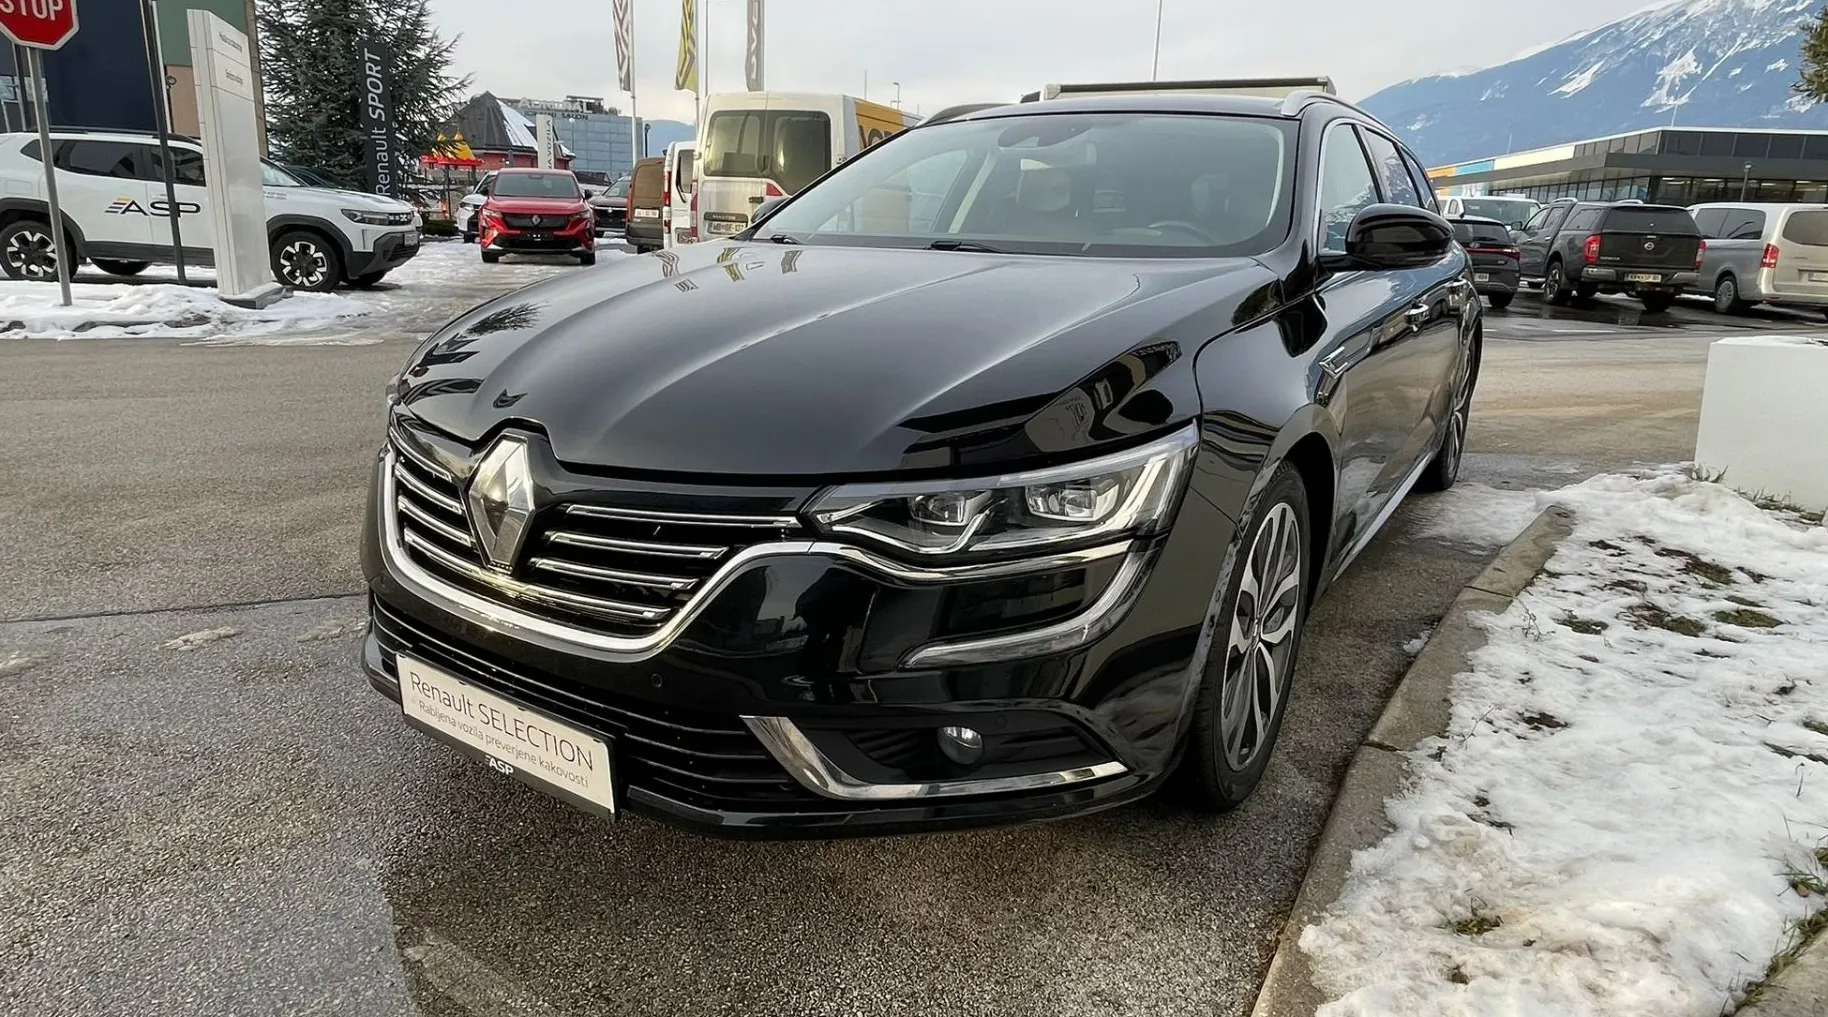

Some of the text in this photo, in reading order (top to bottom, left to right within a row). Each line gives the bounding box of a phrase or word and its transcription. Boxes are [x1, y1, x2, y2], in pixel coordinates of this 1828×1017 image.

[0, 0, 63, 20] STOP
[364, 48, 390, 195] Renault SPORT
[120, 200, 201, 217] ASP
[410, 671, 593, 771] Renault SELECTION
[419, 701, 589, 788] Rabljena vozila preverjene kakovosti
[488, 758, 514, 776] ASP
